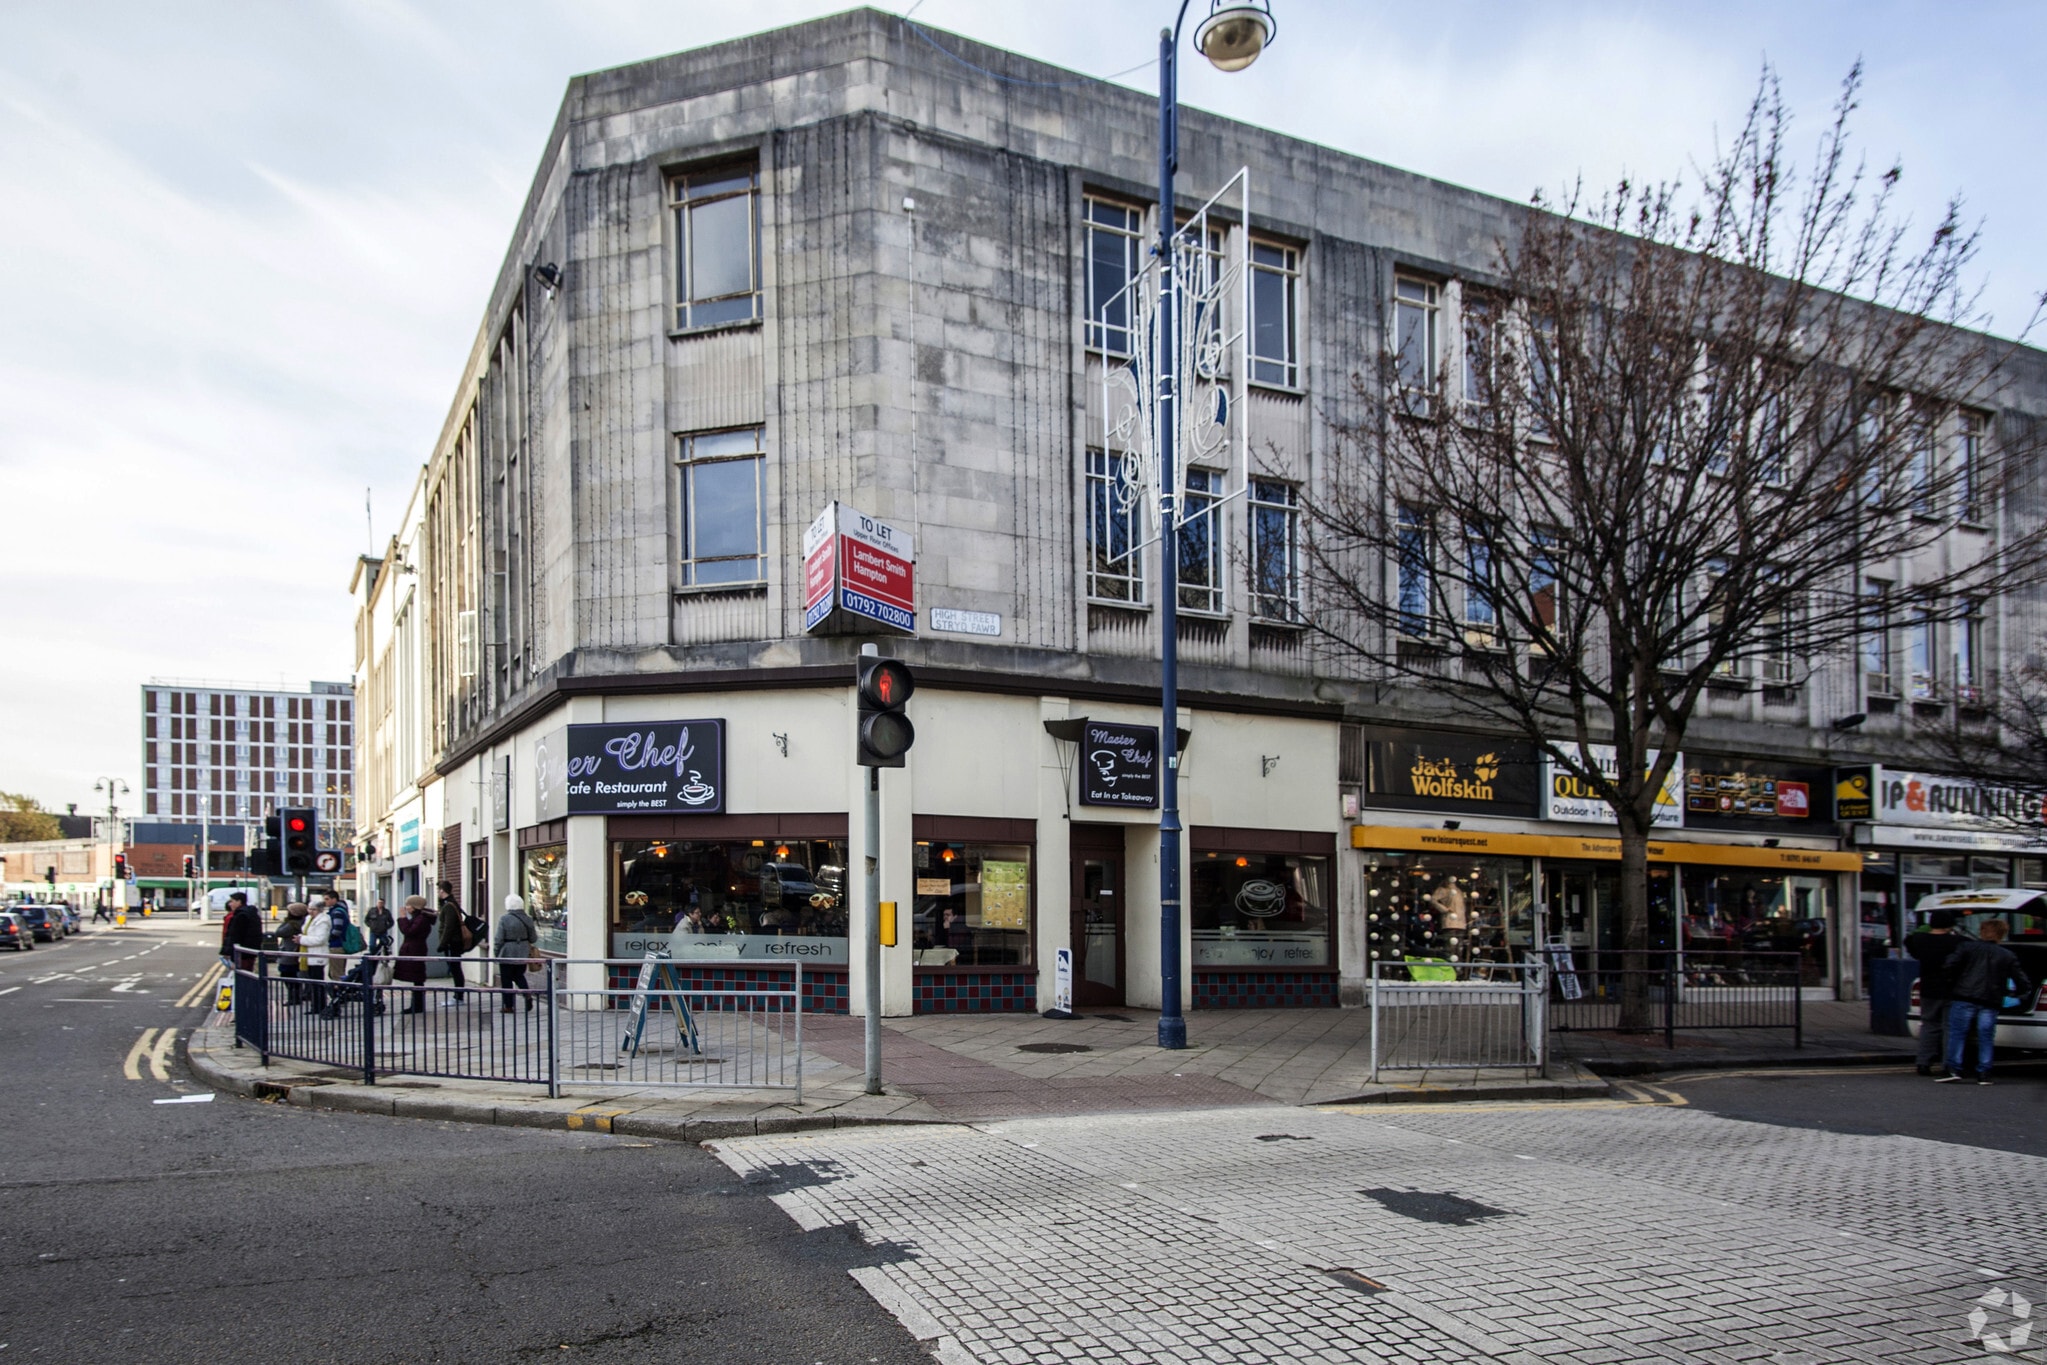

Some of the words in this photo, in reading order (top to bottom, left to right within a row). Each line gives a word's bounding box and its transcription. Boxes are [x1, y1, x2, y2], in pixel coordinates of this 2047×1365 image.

[859, 516, 873, 532] TO
[876, 523, 892, 541] LET
[853, 529, 869, 543] Upper
[869, 534, 882, 548] Floor
[853, 546, 884, 570] Lambert
[886, 560, 906, 577] Smith
[853, 563, 887, 584] Hampton
[846, 592, 875, 615] 01792
[877, 603, 911, 627] 702800
[934, 609, 959, 621] HIGH
[961, 611, 995, 624] STREET
[935, 620, 967, 632] STRYD
[971, 621, 996, 634] FAWR
[1091, 729, 1137, 746] Master
[605, 726, 695, 777] Chef
[1121, 748, 1153, 769] Chef
[1411, 756, 1457, 778] Jack
[565, 781, 591, 795] Cafe
[595, 781, 668, 794] Restaurant
[1091, 790, 1102, 799] Eat
[1103, 791, 1111, 799] In
[1121, 792, 1153, 803] Takeaway
[1410, 775, 1494, 801] Wolfskin
[617, 800, 637, 809] simply
[638, 800, 650, 808] the
[650, 799, 667, 808] BEST
[1553, 804, 1589, 816] Outdoor
[1421, 835, 1488, 847] www.leisurequest.net
[625, 939, 669, 951] relax
[765, 941, 832, 956] refresh
